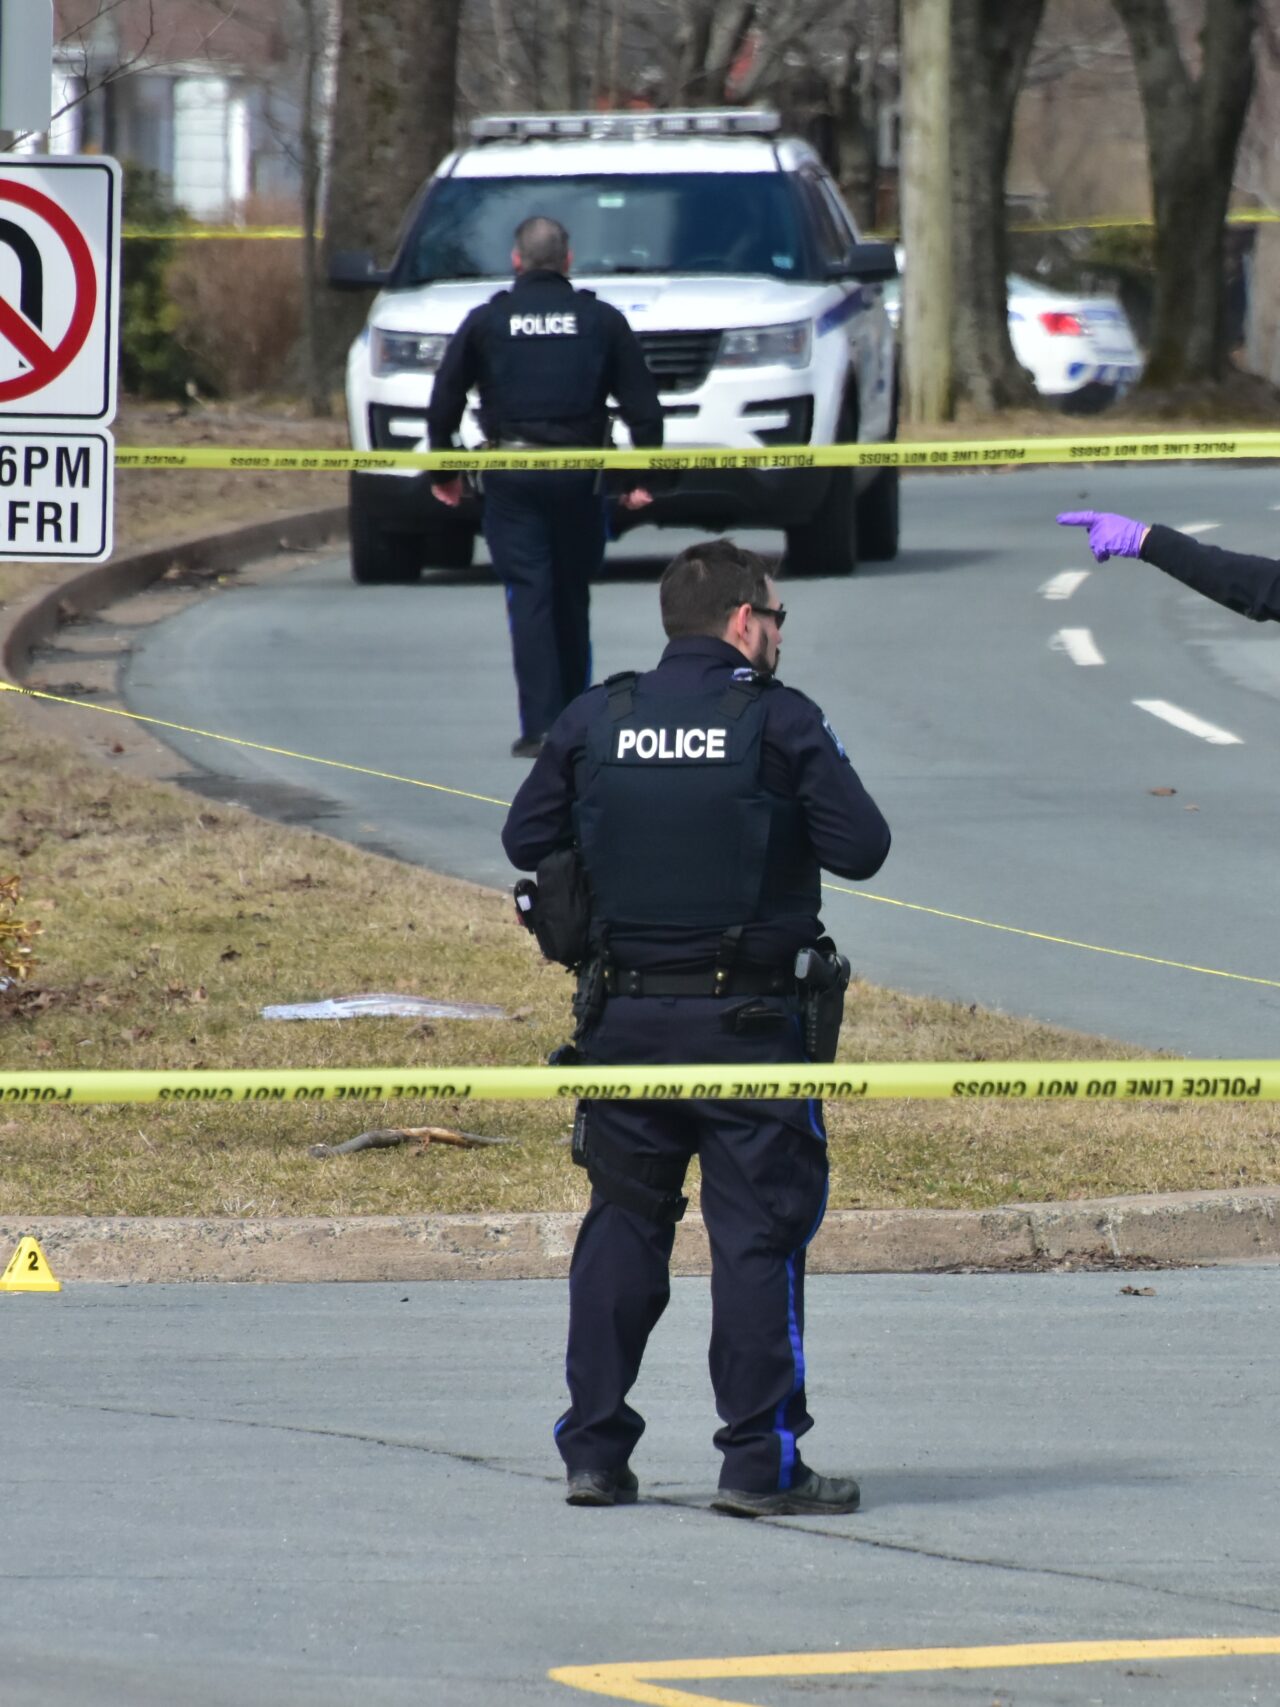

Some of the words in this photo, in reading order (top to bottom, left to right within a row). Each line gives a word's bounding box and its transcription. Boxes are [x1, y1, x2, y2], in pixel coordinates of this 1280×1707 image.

[510, 312, 578, 336] POLICE
[1070, 446, 1111, 457] CROSS
[1113, 445, 1137, 456] NOT
[1141, 444, 1159, 455] DO
[1162, 443, 1188, 454] LINE
[1193, 442, 1236, 453] POLICE
[858, 453, 898, 464] CROSS
[903, 452, 927, 463] NOT
[930, 451, 948, 462] DO
[952, 450, 978, 461] LINE
[982, 448, 1025, 459] POLICE
[144, 455, 186, 464] POLICE
[230, 457, 273, 467] CROSS
[274, 457, 297, 467] NOT
[302, 457, 318, 467] DO
[323, 458, 349, 468] LINE
[352, 458, 396, 468] POLICE
[440, 460, 479, 469] CROSS
[484, 459, 507, 468] NOT
[511, 459, 527, 468] DO
[532, 459, 558, 468] LINE
[562, 458, 605, 468] POLICE
[648, 457, 689, 469] CROSS
[693, 457, 717, 468] NOT
[720, 456, 737, 468] DO
[741, 456, 768, 468] LINE
[771, 454, 814, 467] POLICE
[0, 446, 90, 488] 6PM
[8, 500, 79, 543] FRI
[617, 728, 727, 759] POLICE
[391, 1085, 471, 1099] POLICE
[557, 1085, 632, 1099] CROSS
[641, 1085, 684, 1099] NOT
[690, 1084, 722, 1098] DO
[731, 1083, 780, 1098] LINE
[788, 1082, 868, 1098] POLICE
[952, 1081, 1027, 1098] CROSS
[1036, 1080, 1078, 1097] NOT
[1086, 1080, 1117, 1097] DO
[1126, 1079, 1174, 1097] LINE
[1181, 1077, 1261, 1097] POLICE
[334, 1086, 383, 1100] LINE
[28, 1251, 39, 1271] 2
